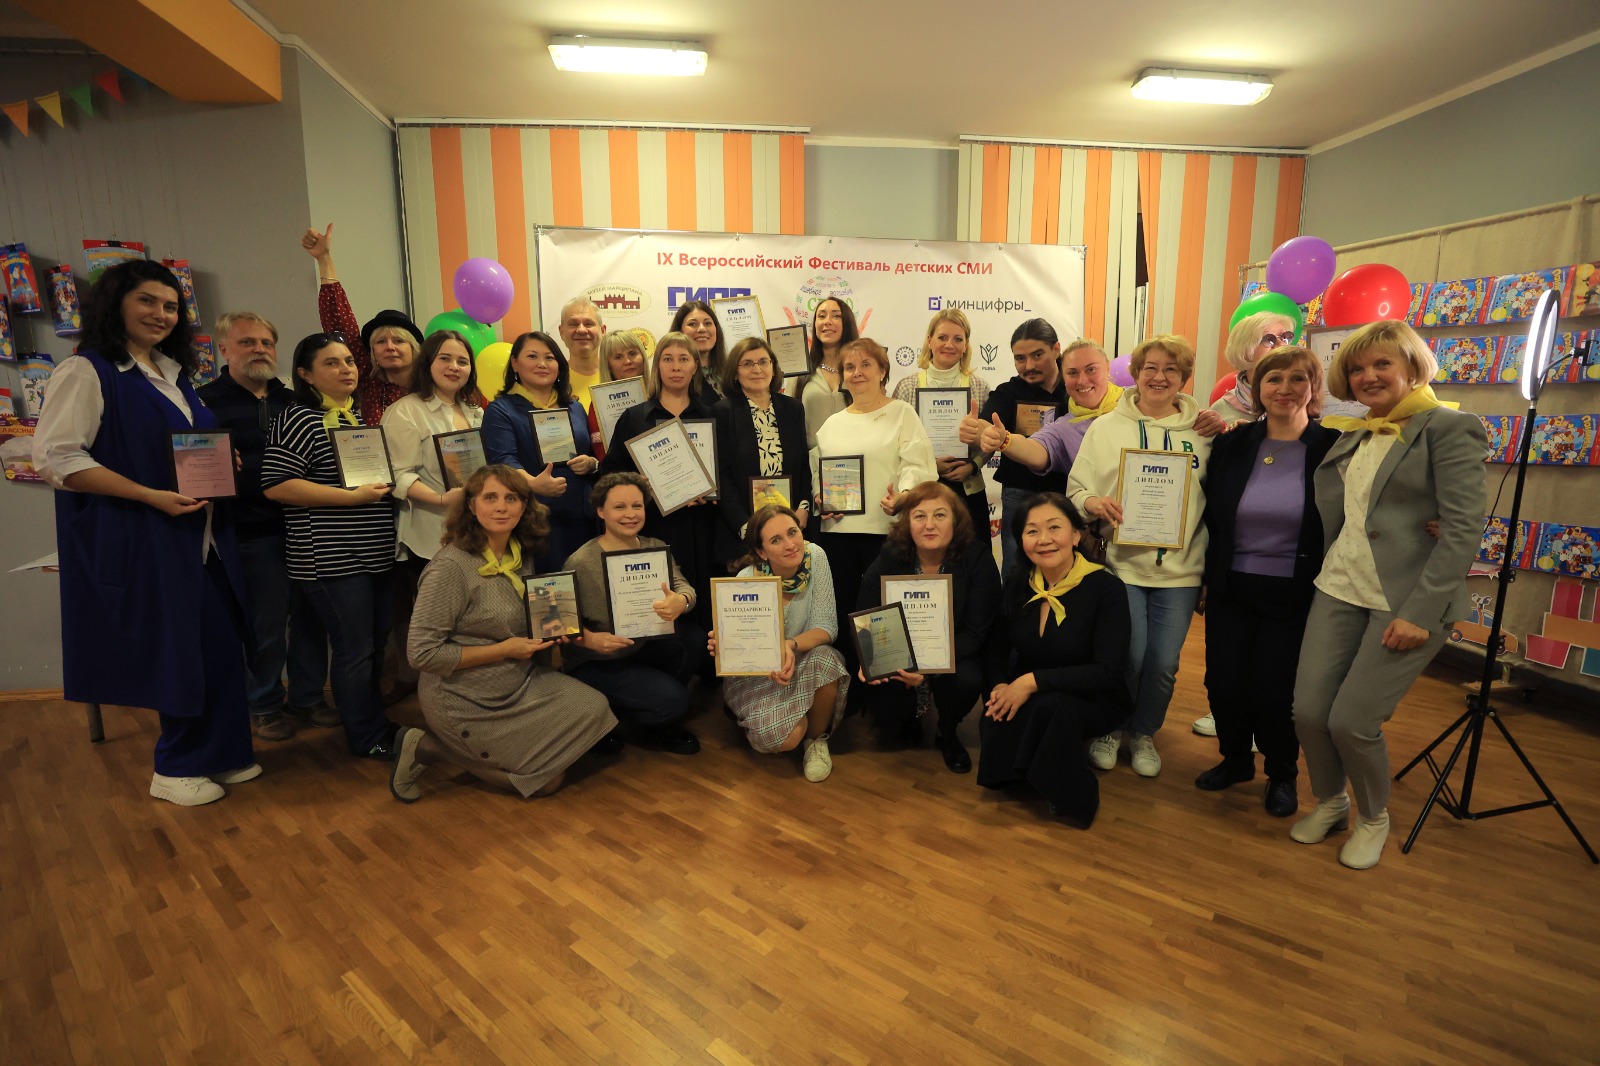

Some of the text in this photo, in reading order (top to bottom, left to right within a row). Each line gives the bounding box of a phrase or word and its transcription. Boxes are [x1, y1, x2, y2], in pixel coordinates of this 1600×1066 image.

[657, 252, 993, 275] IX Всероссийский Фестиваль детских СМИ
[608, 390, 630, 401] ГИПП
[1142, 465, 1169, 475] ГИПП
[1134, 476, 1174, 485] ДИПЛОМ
[624, 562, 651, 572] ГИПП
[619, 572, 658, 583] ДИПЛОМ
[732, 593, 759, 602] ГИПП
[903, 591, 930, 599] ГИПП
